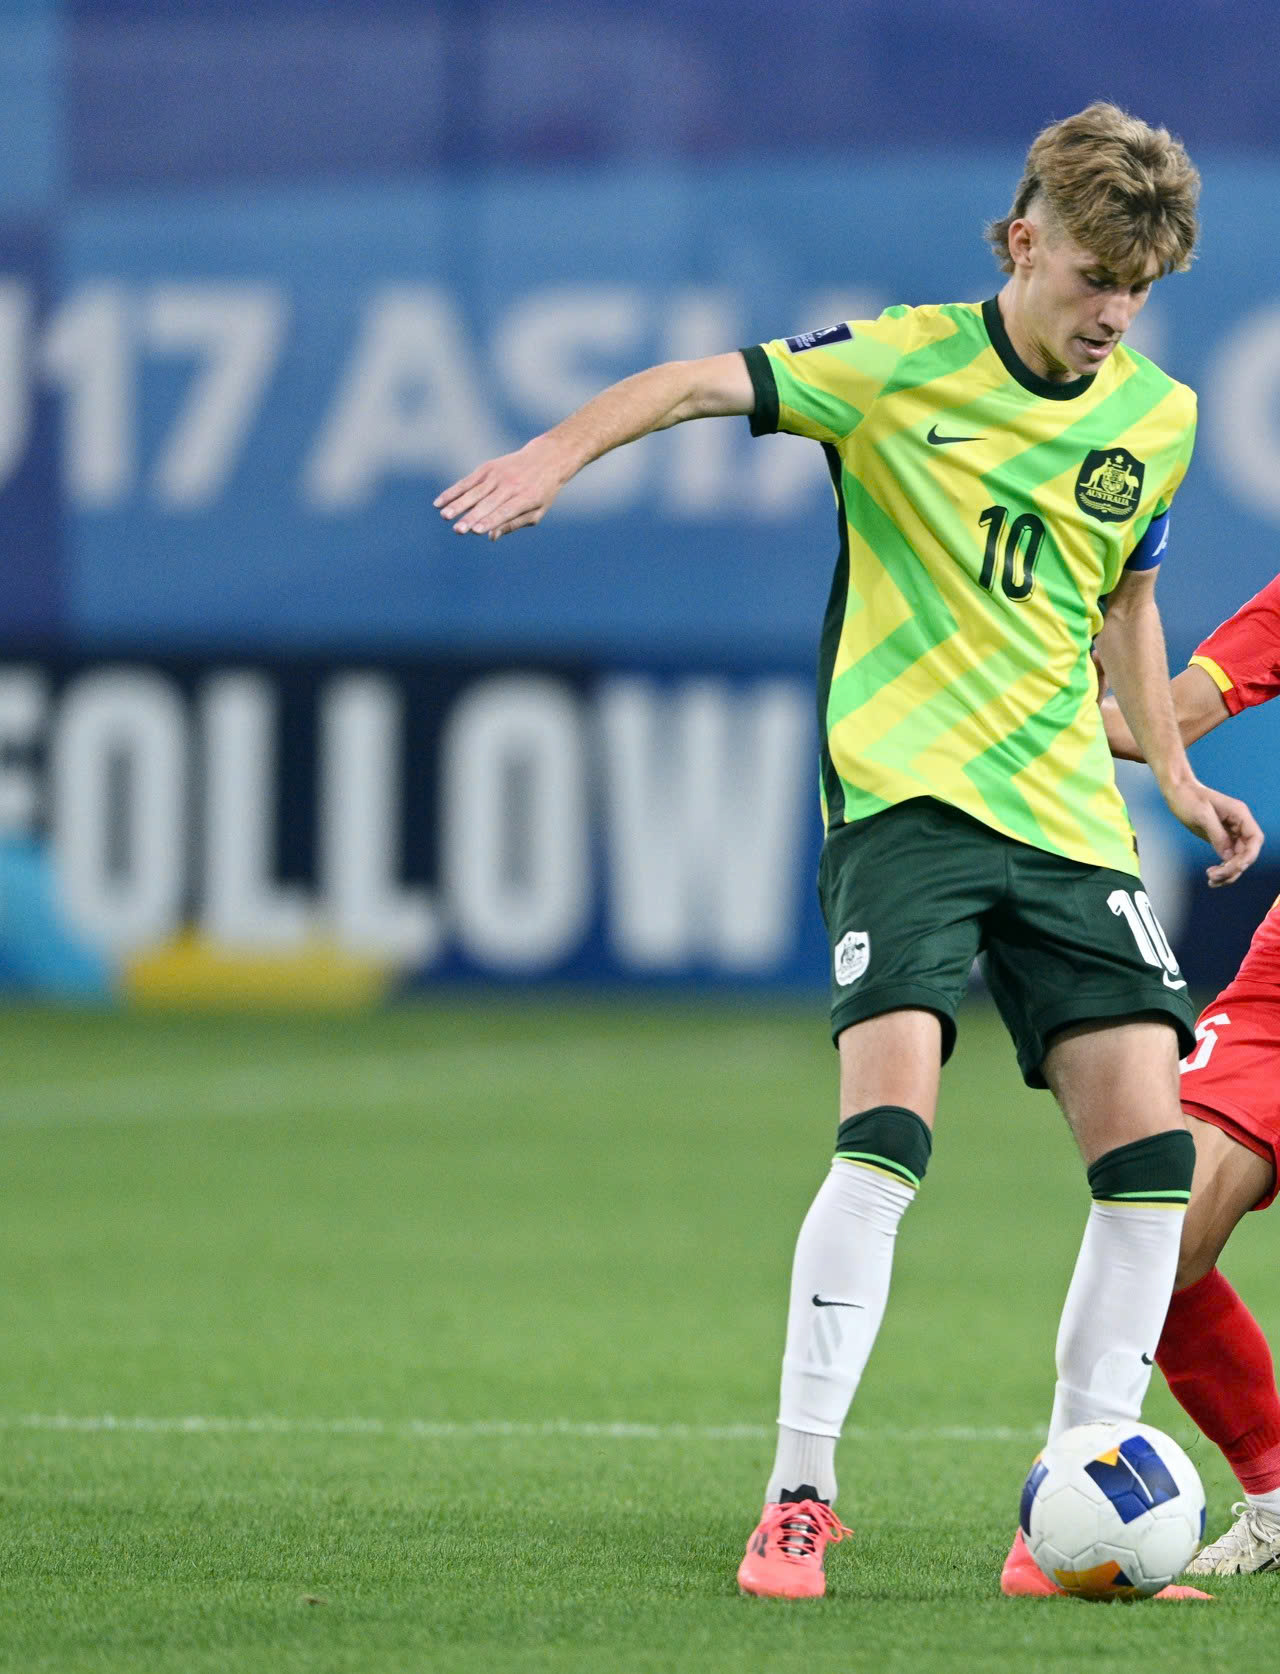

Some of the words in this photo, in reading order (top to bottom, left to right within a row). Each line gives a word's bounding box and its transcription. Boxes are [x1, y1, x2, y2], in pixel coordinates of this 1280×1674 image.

[1086, 489, 1130, 507] AUSTRALIA
[979, 505, 1046, 603] 10
[1106, 889, 1180, 976] 10
[1179, 1013, 1231, 1075] 5
